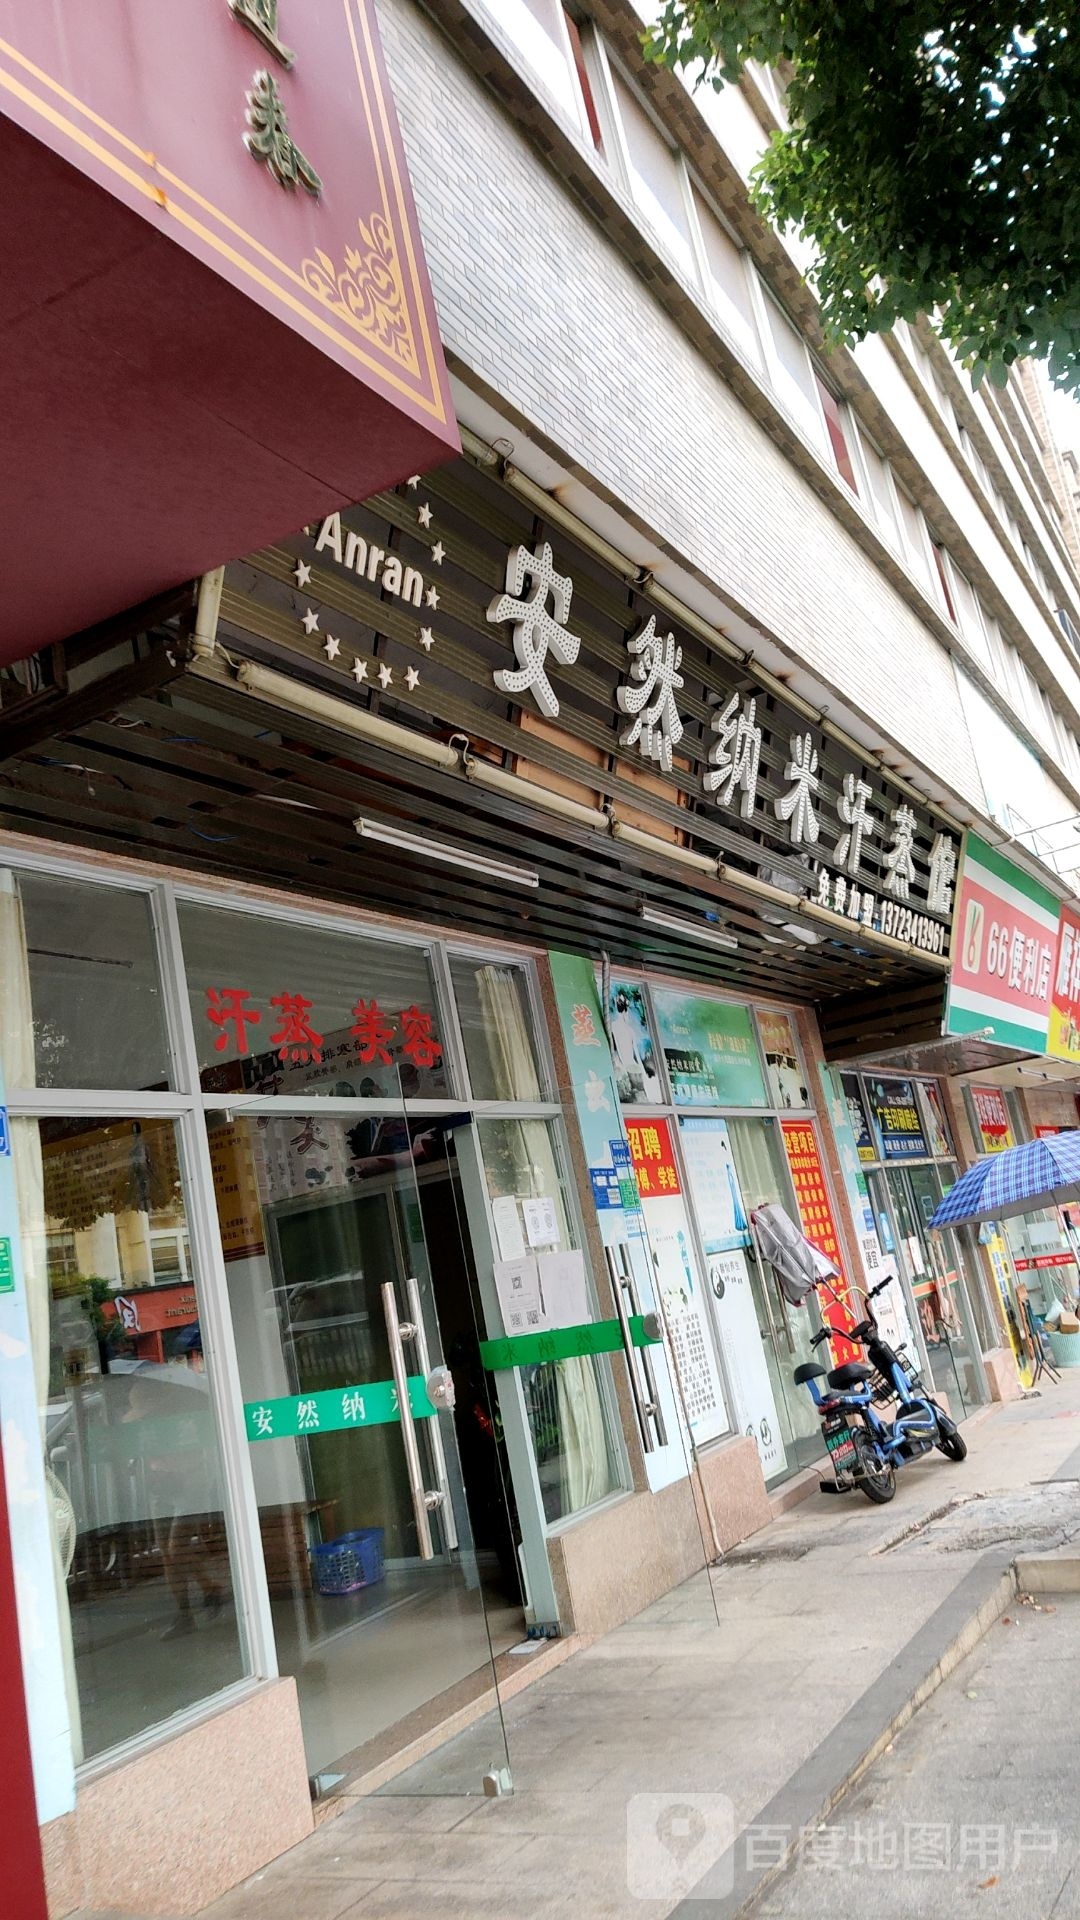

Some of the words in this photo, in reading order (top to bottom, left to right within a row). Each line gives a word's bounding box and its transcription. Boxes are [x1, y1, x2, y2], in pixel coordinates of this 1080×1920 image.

[315, 512, 424, 608] Anran
[486, 541, 956, 915] 安然纳米汗蒸馆
[987, 921, 1052, 1001] 66便利店
[206, 986, 324, 1065] 汗蒸
[349, 999, 443, 1067] 美容
[627, 1127, 662, 1160] 招聘
[634, 1166, 678, 1191] 傅、学徒
[784, 1130, 816, 1154] 经营项目
